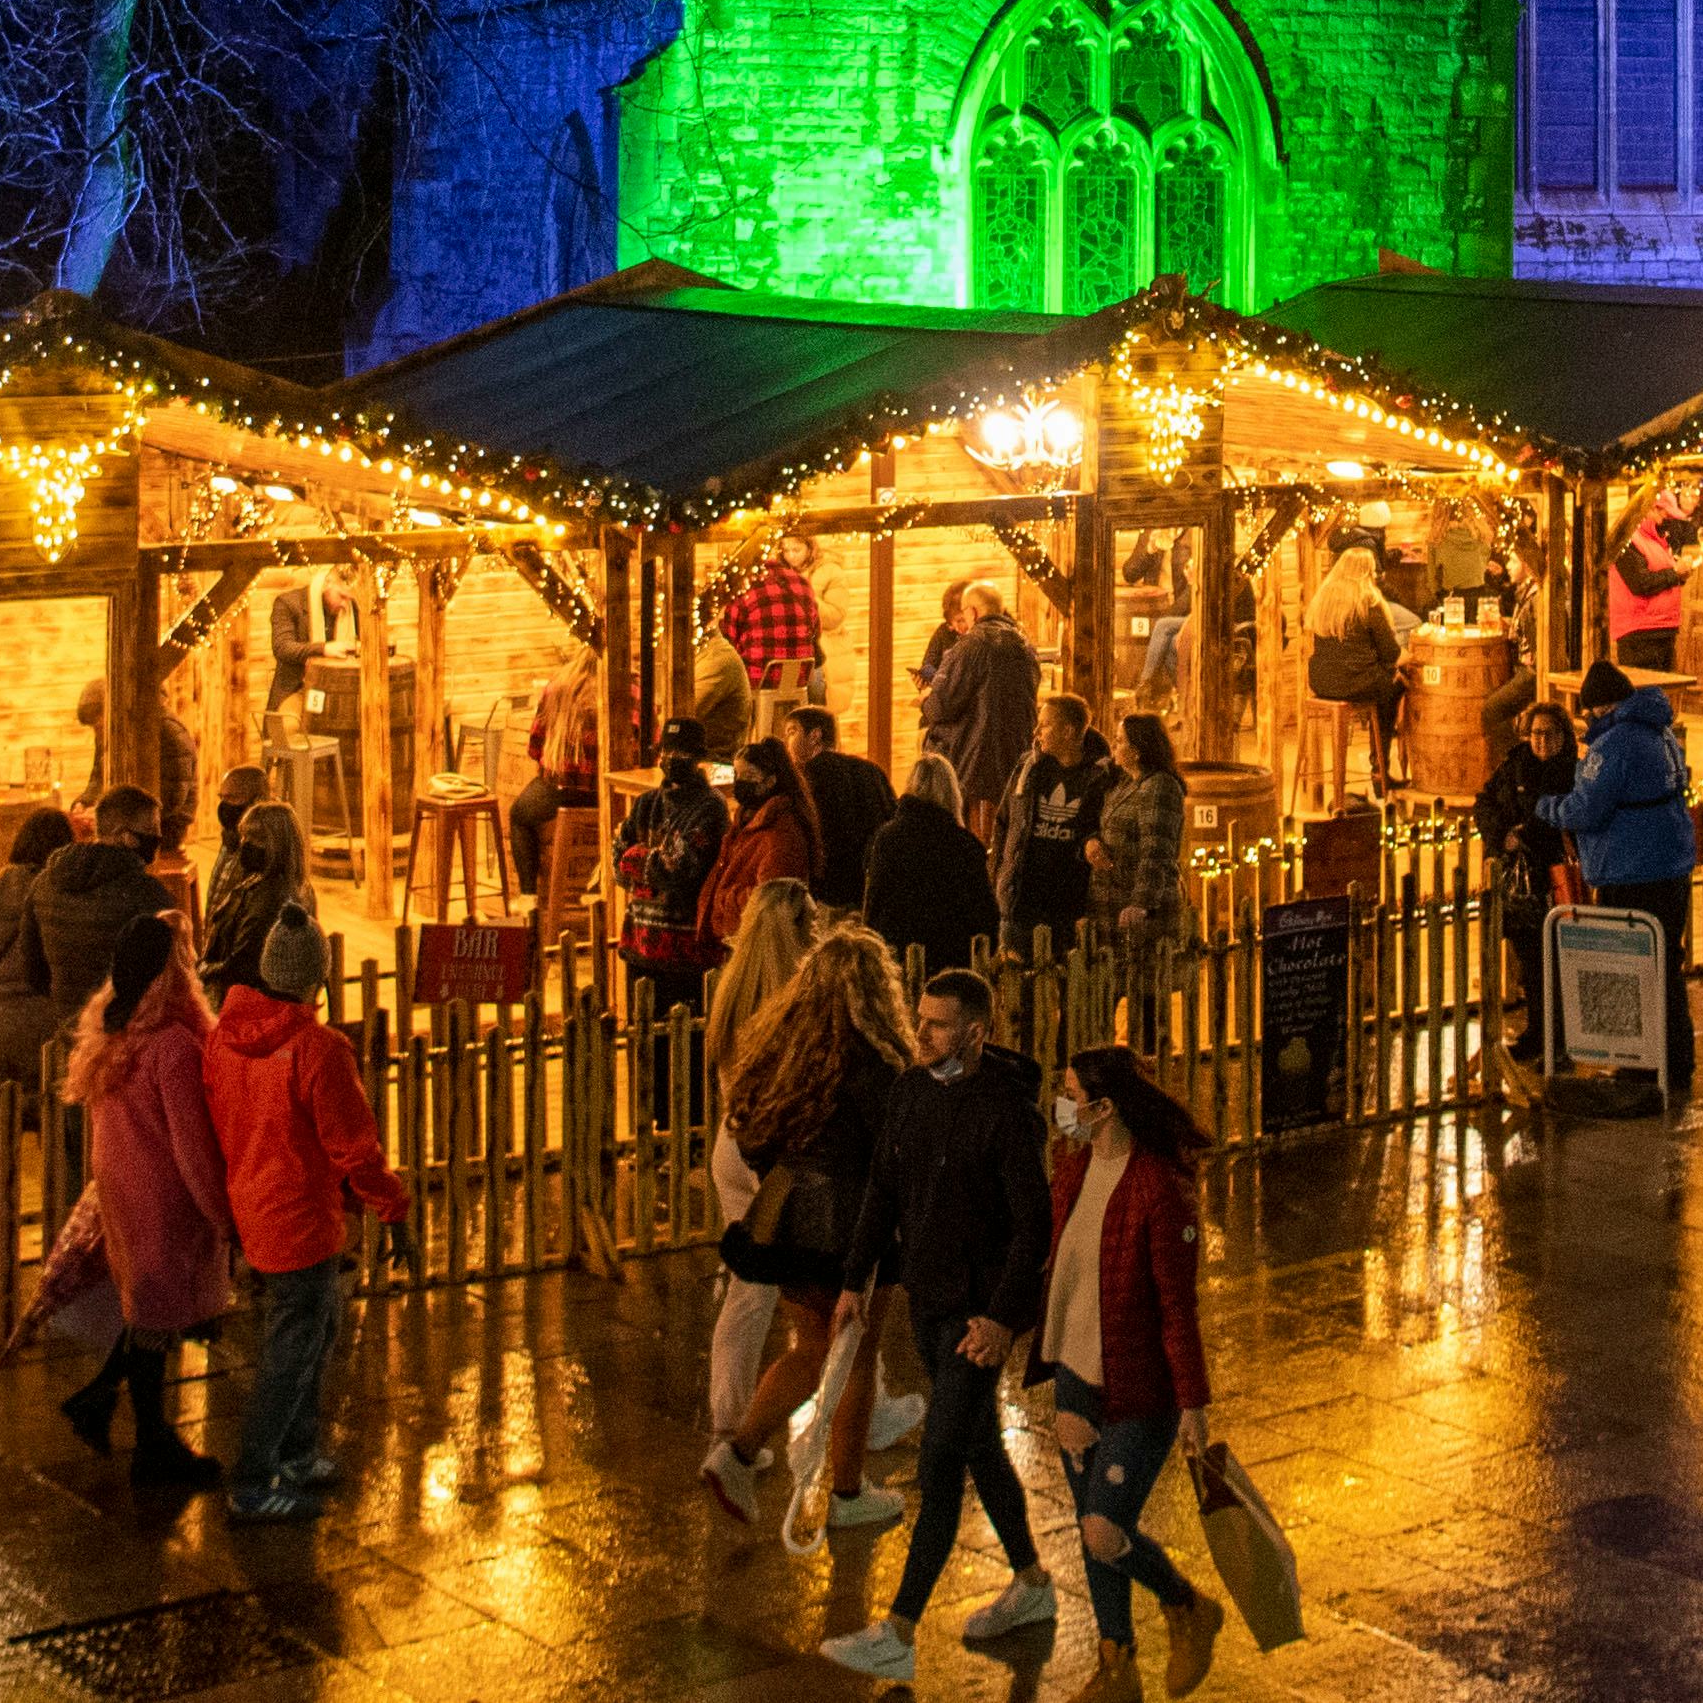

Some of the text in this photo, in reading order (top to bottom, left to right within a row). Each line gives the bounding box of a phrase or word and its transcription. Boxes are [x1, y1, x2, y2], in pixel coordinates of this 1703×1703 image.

[1199, 809, 1214, 824] 16
[454, 928, 498, 958] BAR
[1288, 936, 1323, 950] Hot
[1267, 951, 1347, 975] Chocolate
